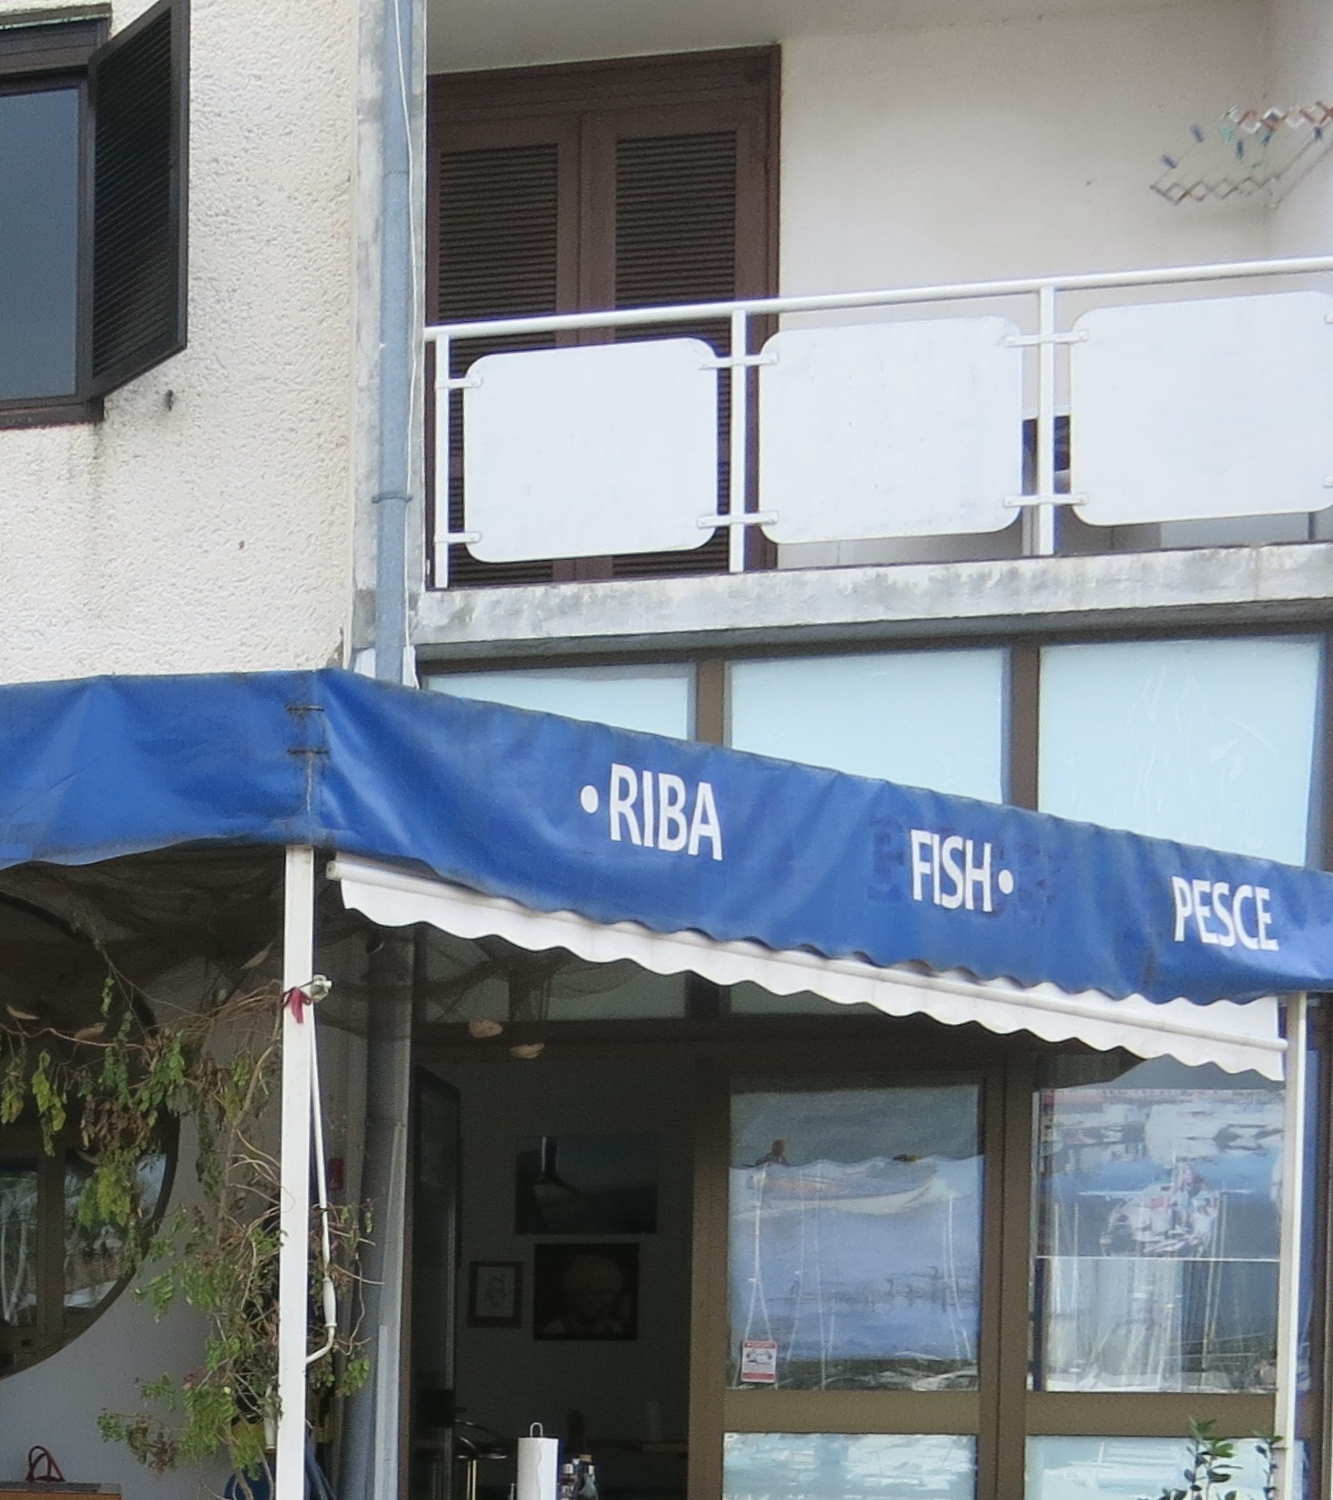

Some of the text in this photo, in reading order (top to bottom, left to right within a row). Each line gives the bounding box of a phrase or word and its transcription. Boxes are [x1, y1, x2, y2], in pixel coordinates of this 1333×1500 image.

[610, 763, 1280, 951] RIBA FISH PESCE
